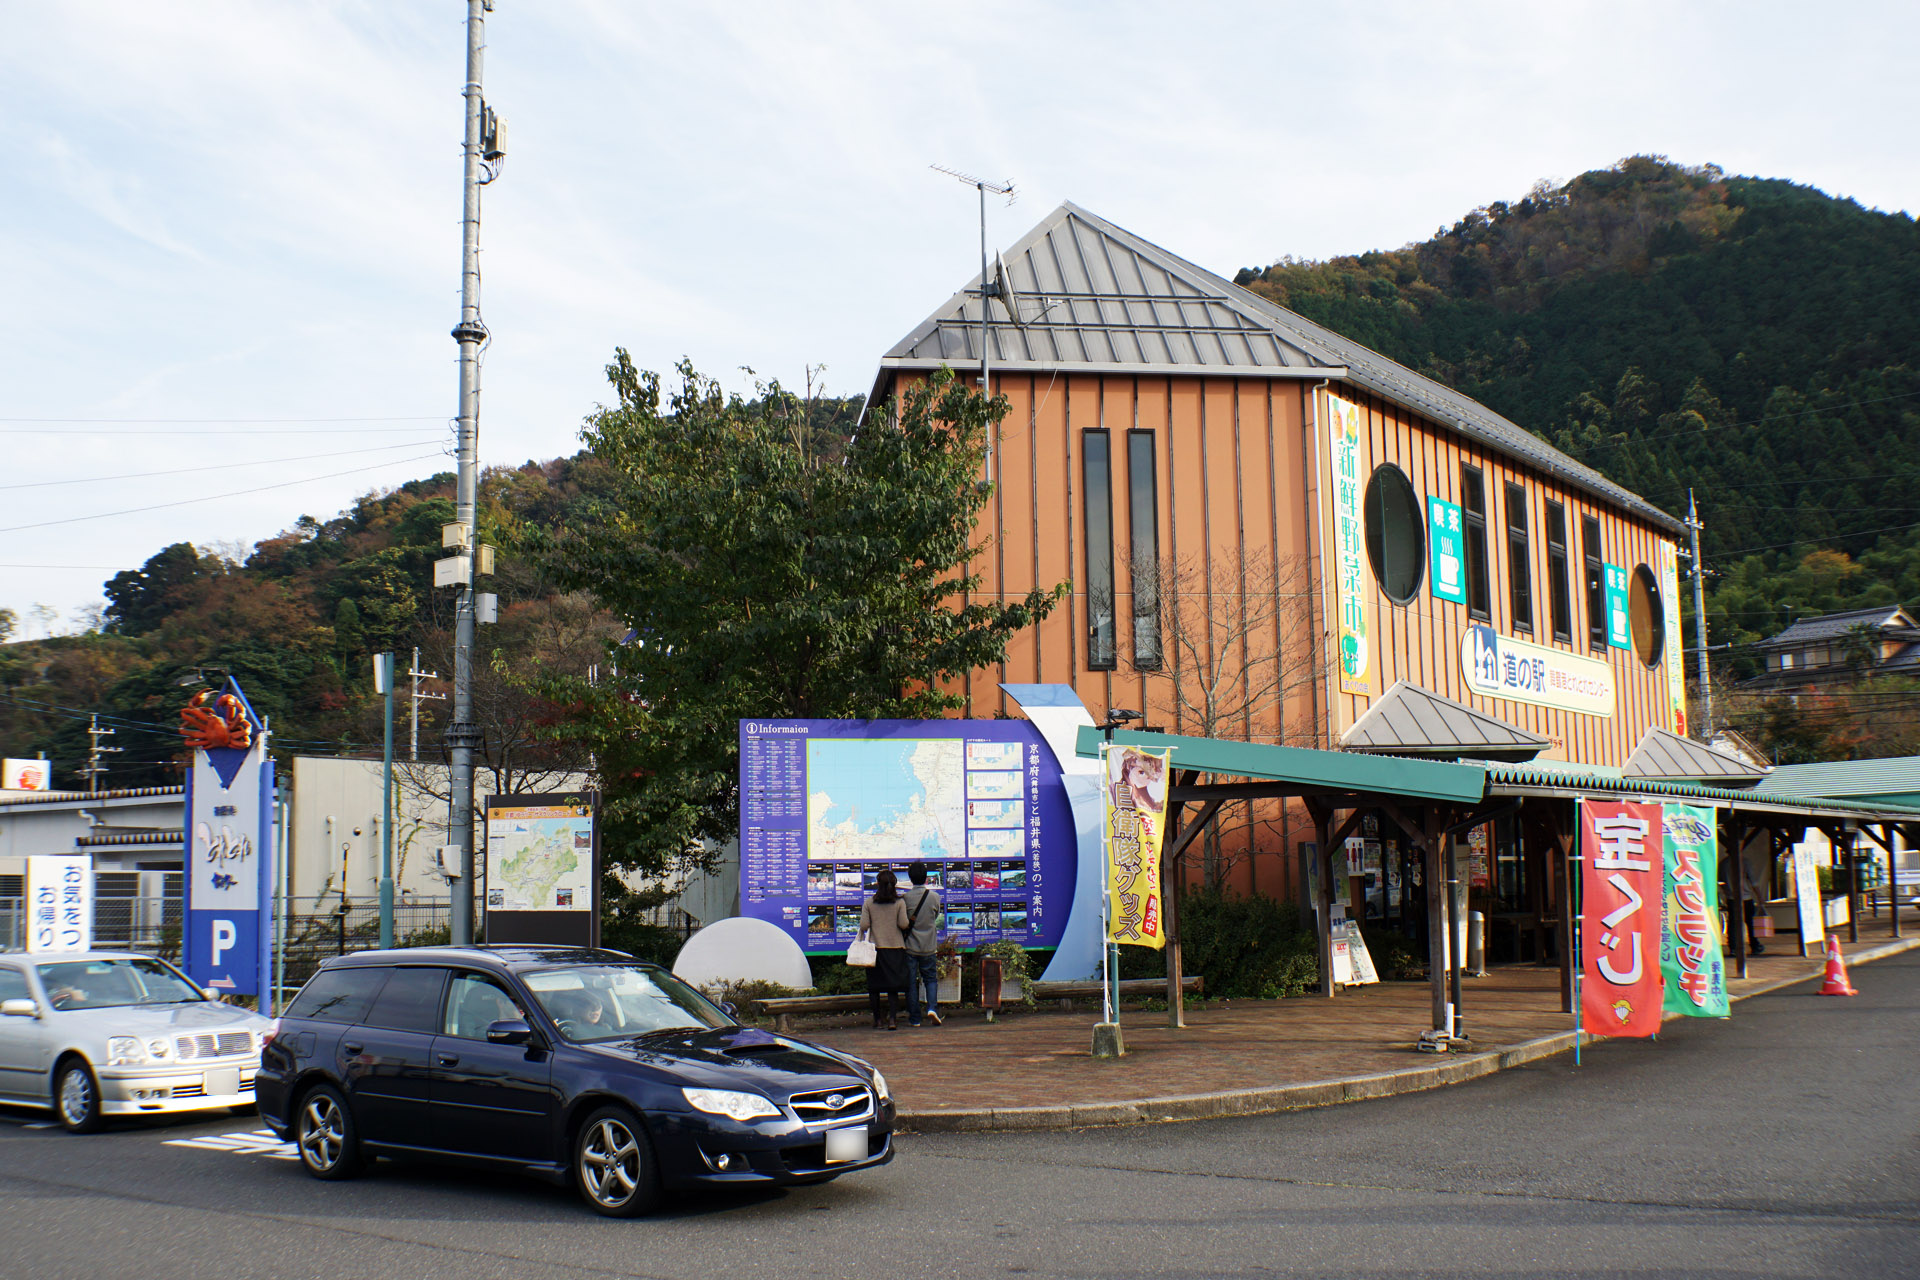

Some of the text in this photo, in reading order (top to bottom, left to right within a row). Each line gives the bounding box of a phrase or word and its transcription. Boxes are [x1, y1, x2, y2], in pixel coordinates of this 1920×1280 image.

[1338, 440, 1361, 632] 新鮮野菜市
[1433, 503, 1459, 532] 喫茶
[1608, 568, 1625, 591] 喫茶
[1503, 651, 1546, 693] 道の駅
[759, 724, 808, 734] Informaion
[1111, 781, 1142, 941] 自衛隊グッズ
[212, 919, 237, 966] P
